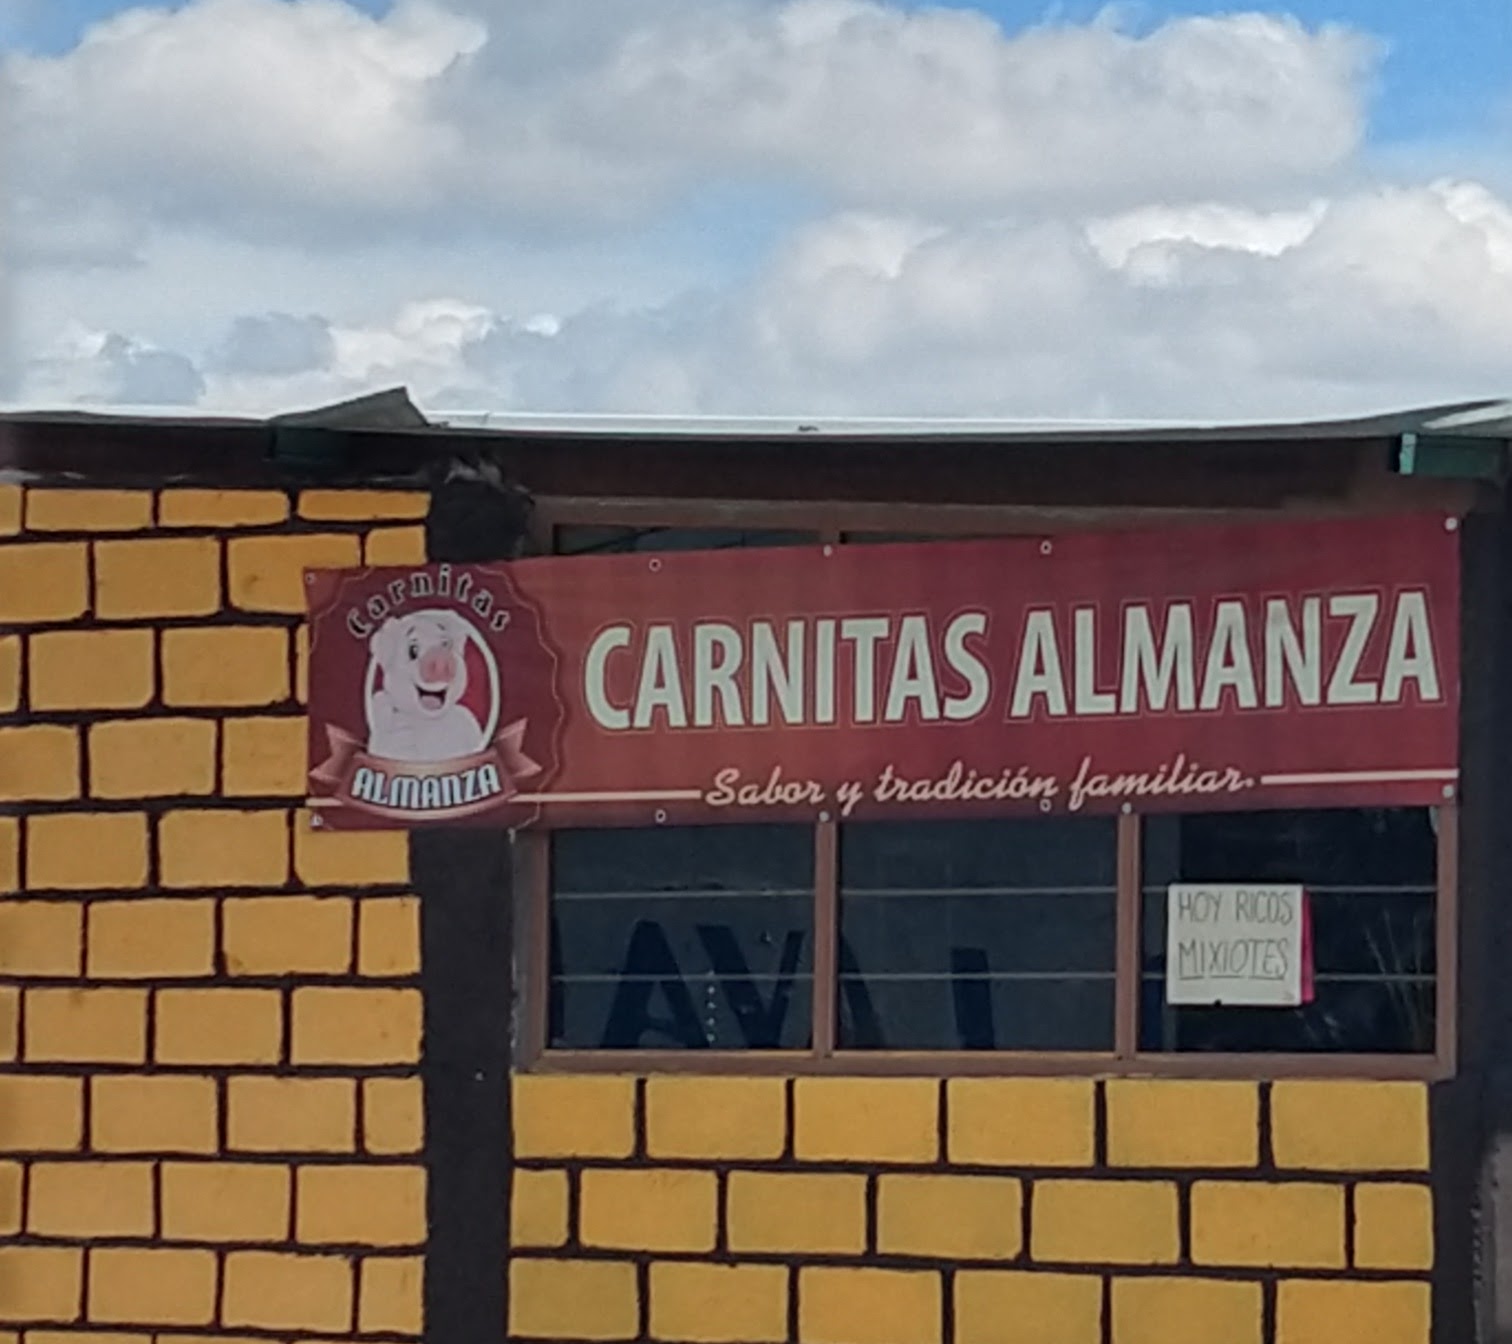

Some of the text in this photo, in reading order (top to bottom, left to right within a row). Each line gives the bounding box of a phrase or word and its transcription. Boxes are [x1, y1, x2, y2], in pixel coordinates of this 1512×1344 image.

[347, 564, 511, 638] Carnitas
[584, 591, 1441, 731] CARNITAS ALMANZA
[351, 763, 501, 810] ALMANZA
[705, 767, 826, 807] Sabor
[835, 781, 864, 817] y
[872, 759, 1059, 803] tradición
[1177, 889, 1294, 926] HOY RICOS
[1177, 937, 1289, 979] MIXIOTES
